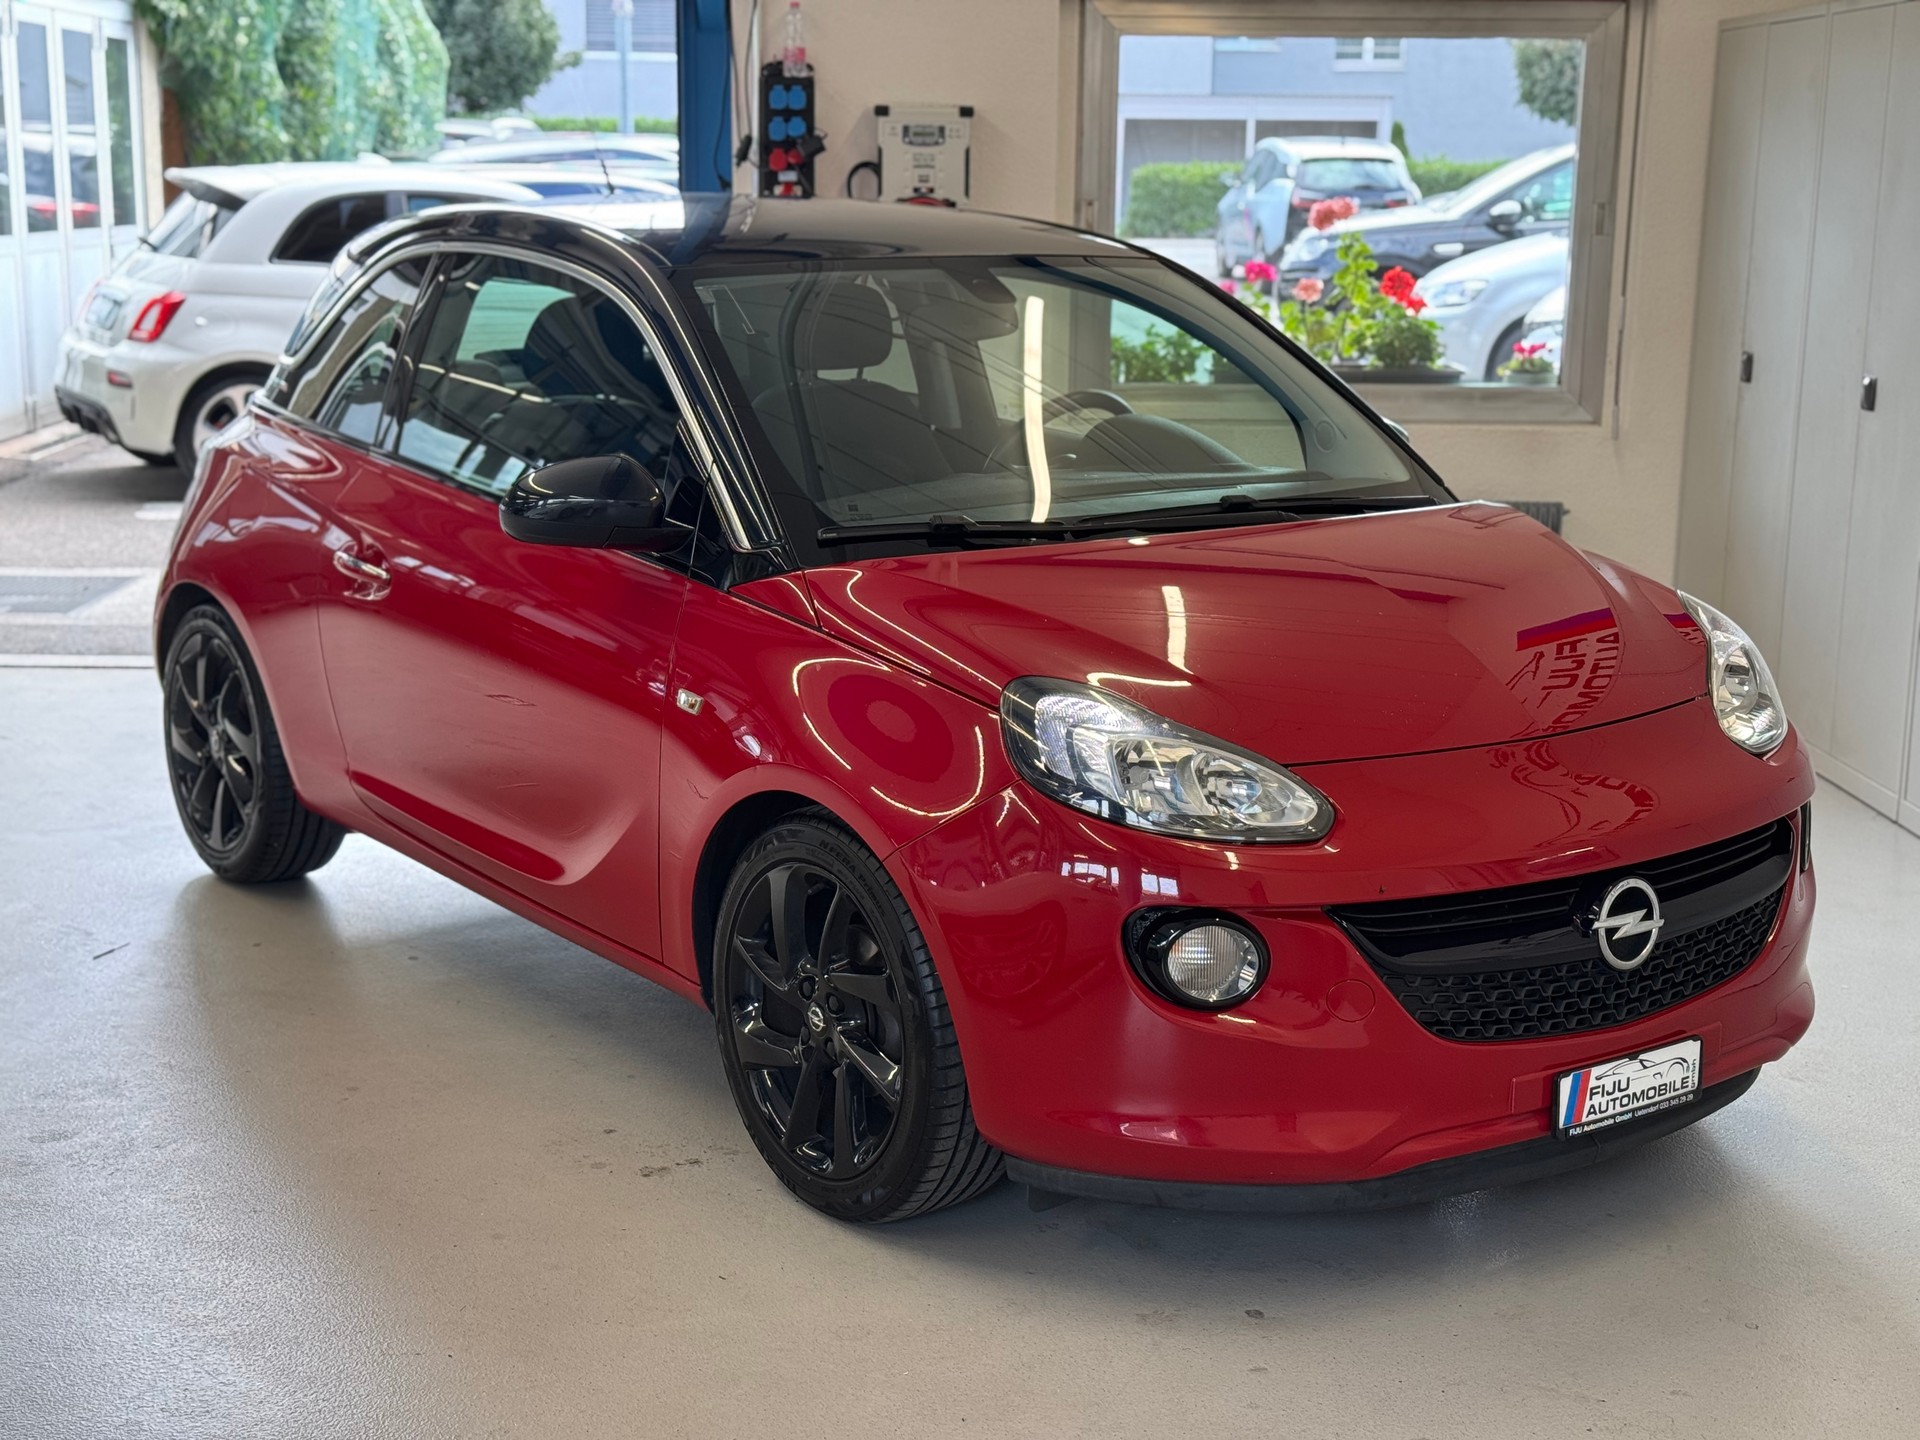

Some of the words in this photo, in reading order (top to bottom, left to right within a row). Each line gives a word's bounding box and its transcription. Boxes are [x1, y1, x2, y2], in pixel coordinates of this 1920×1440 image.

[1586, 1075, 1690, 1118] AUTOMOBILE
[1589, 1076, 1630, 1101] FIJU
[1569, 1126, 1583, 1136] FIJU
[1583, 1118, 1615, 1132] Automobile
[1615, 1111, 1633, 1123] GmbH
[1659, 1101, 1669, 1109] 033
